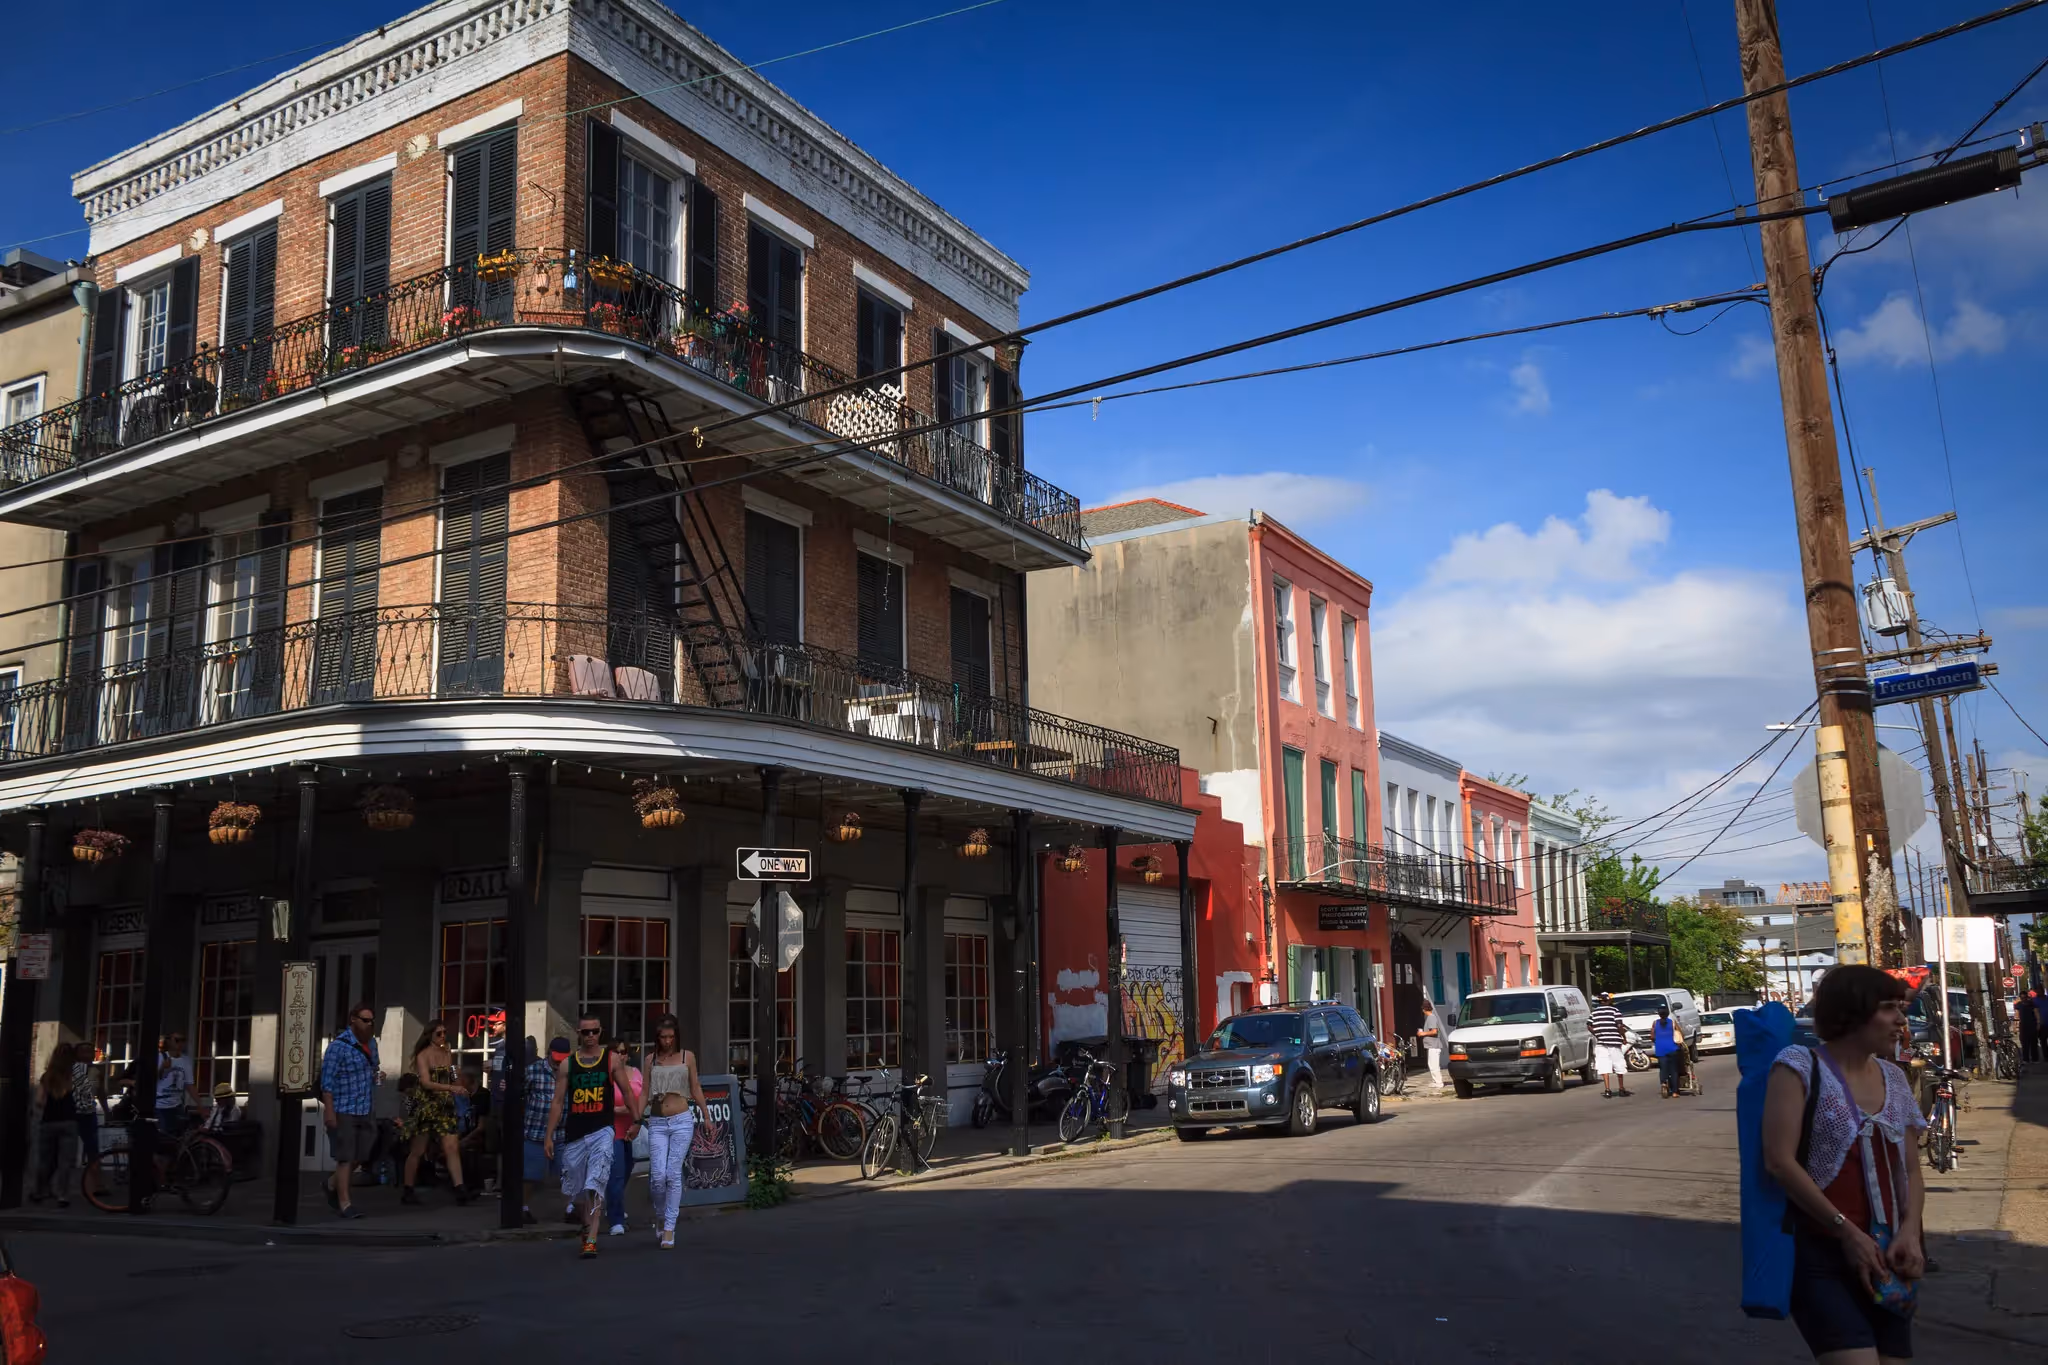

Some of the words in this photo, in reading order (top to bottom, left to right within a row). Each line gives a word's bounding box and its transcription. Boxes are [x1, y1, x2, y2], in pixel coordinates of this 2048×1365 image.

[1873, 667, 1907, 677] HISTORIC
[1938, 655, 1972, 666] DISTRICT
[1878, 670, 1973, 694] Frenchmen
[760, 858, 780, 870] ONE
[783, 859, 803, 871] WAY
[458, 871, 510, 896] DAIL
[288, 971, 308, 1084] TATTOO
[571, 1071, 608, 1089] KEEP
[572, 1086, 605, 1104] ONE
[689, 1103, 731, 1123] ATTOO
